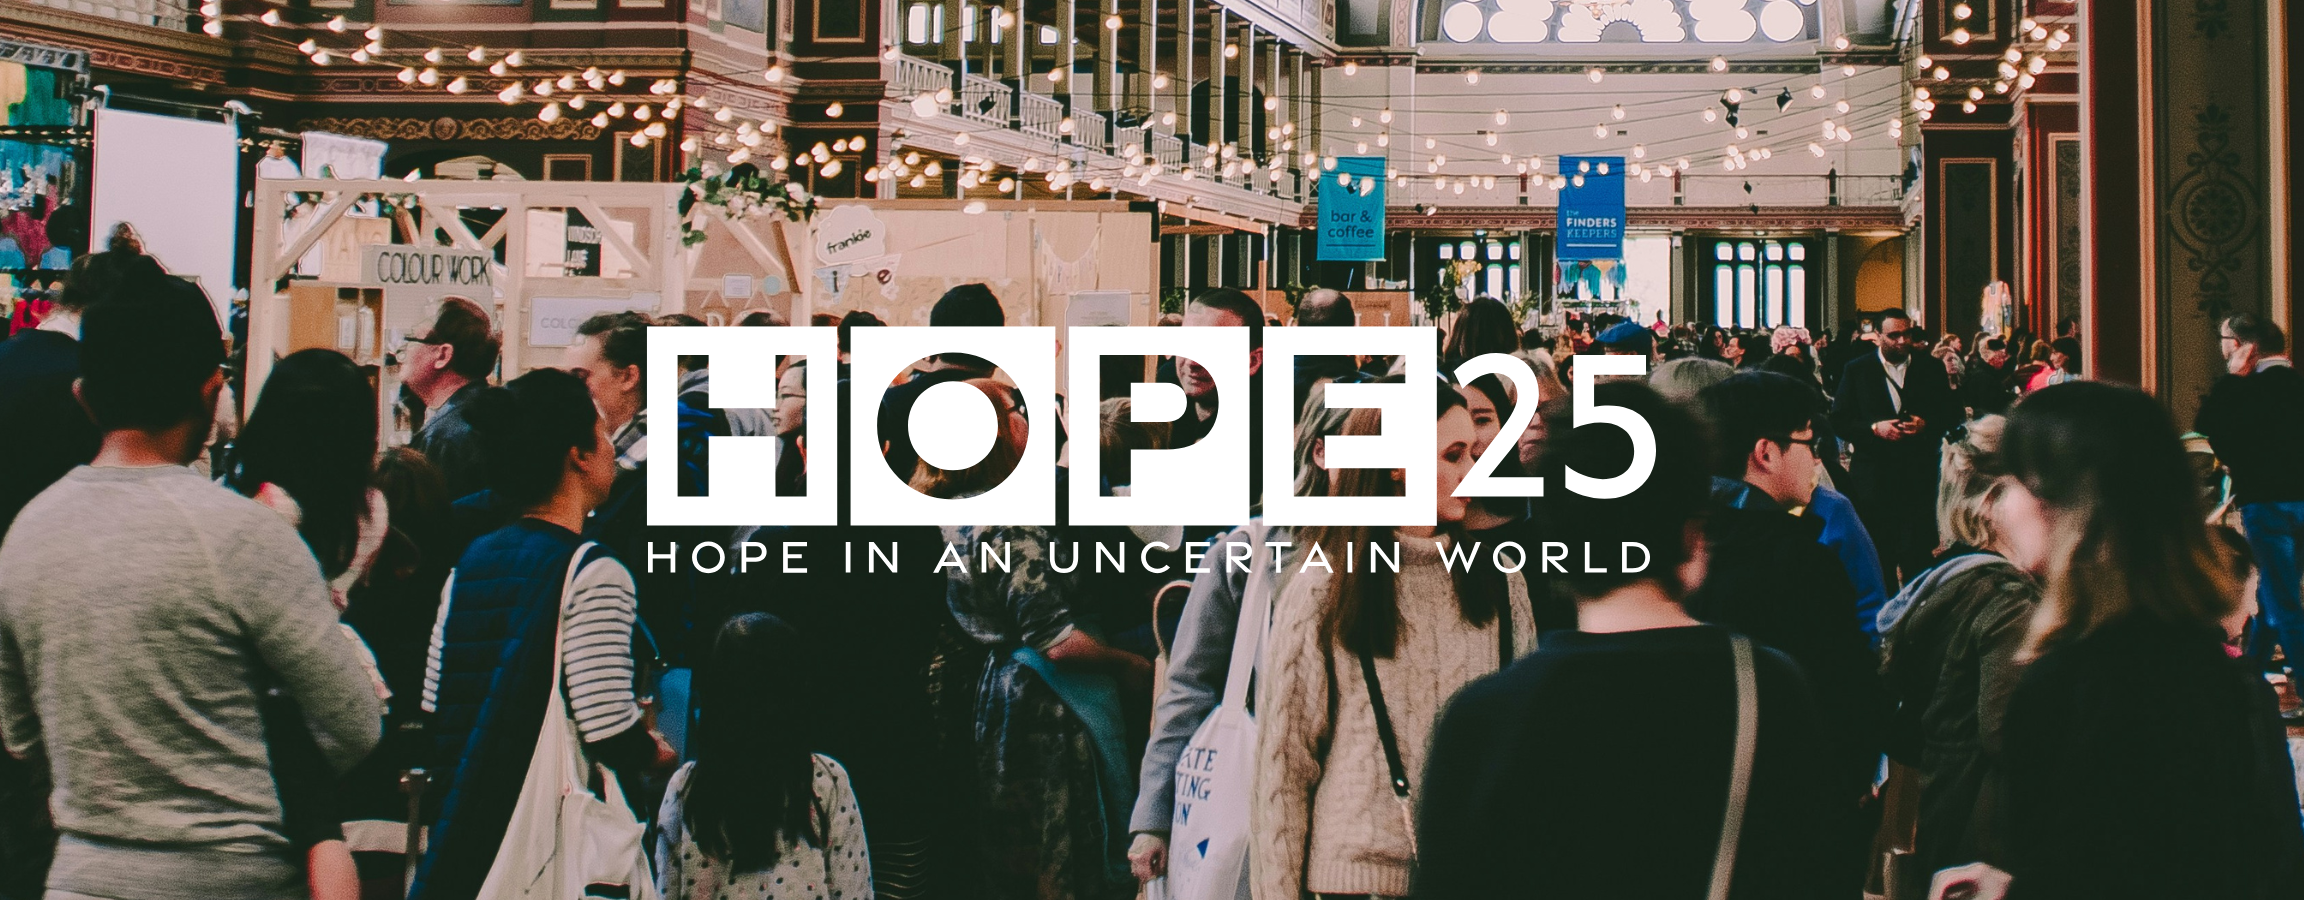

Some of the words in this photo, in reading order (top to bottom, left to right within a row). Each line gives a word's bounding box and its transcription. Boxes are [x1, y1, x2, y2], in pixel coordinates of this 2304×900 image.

[1330, 209, 1357, 223] bar
[1359, 209, 1373, 223] &
[1566, 217, 1618, 229] FINDERS
[1327, 225, 1375, 239] coffee
[1566, 228, 1618, 239] KEEPERS
[825, 228, 872, 255] frankie
[377, 251, 444, 285] COLOUR
[446, 254, 491, 286] WORK
